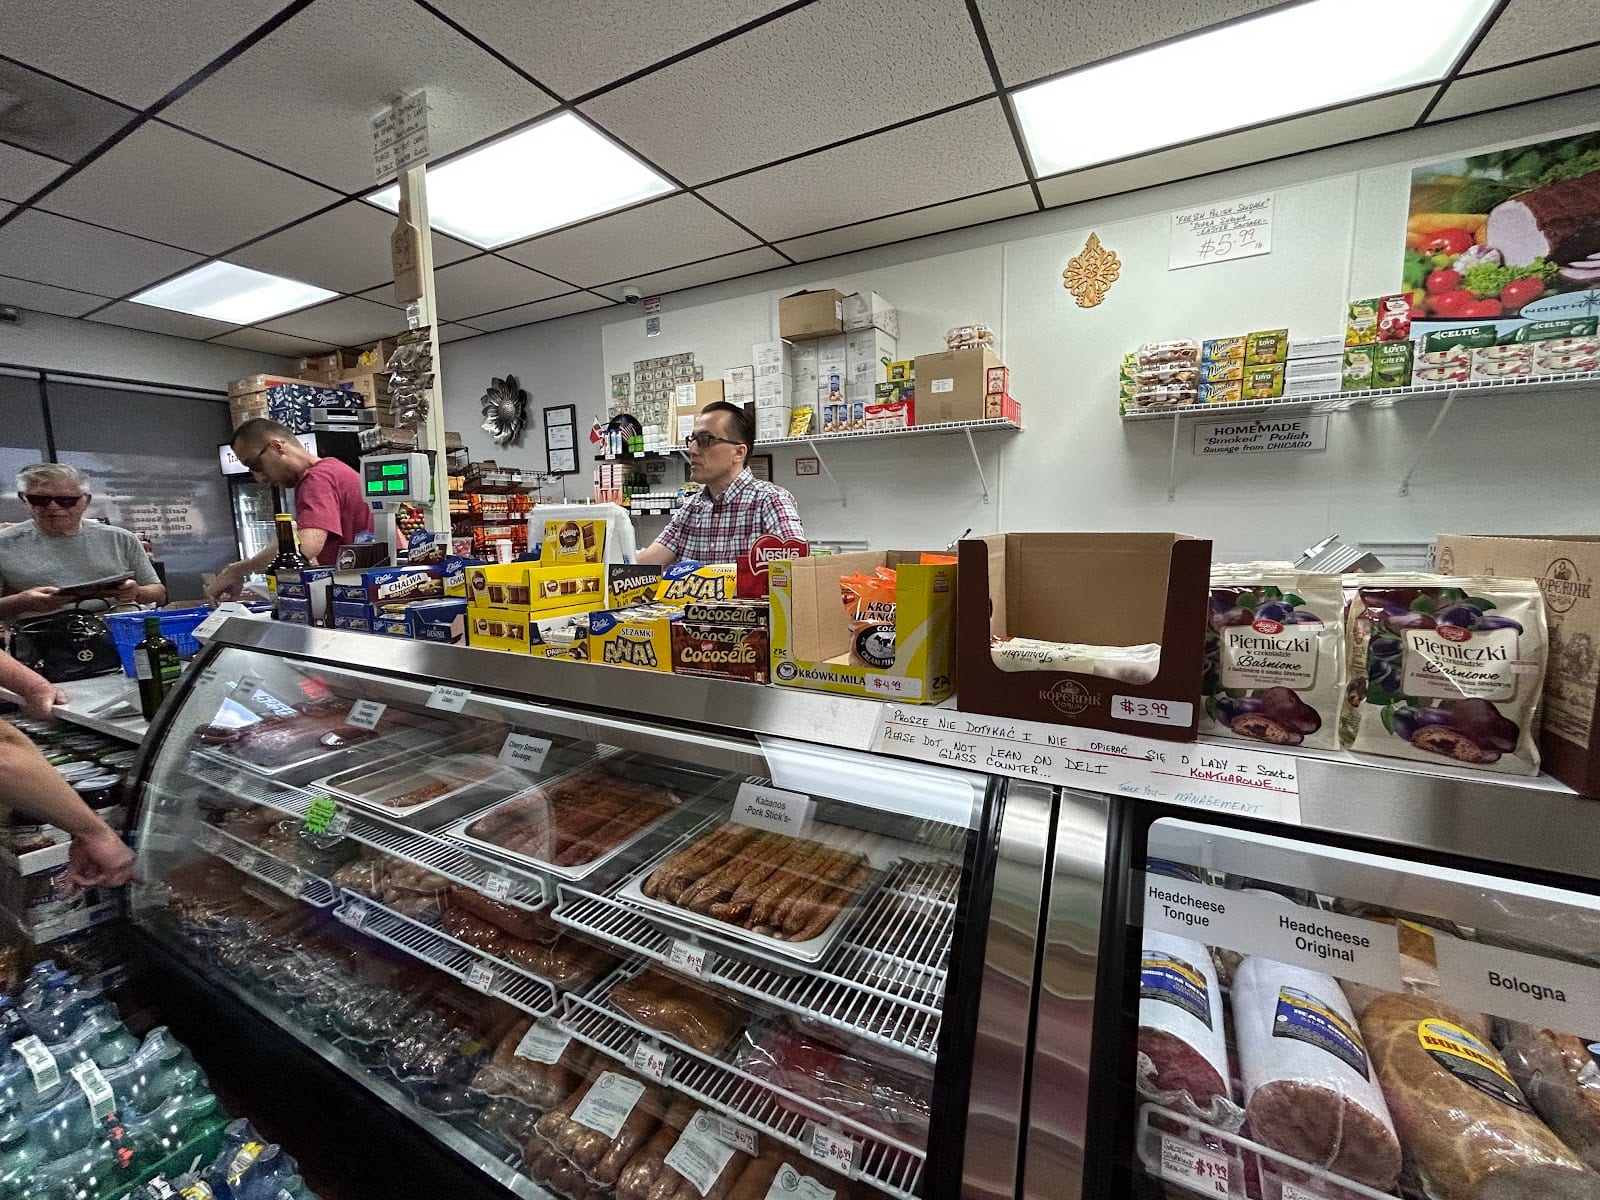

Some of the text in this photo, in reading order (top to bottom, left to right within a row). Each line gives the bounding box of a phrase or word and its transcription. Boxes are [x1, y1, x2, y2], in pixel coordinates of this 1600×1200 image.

[1539, 320, 1569, 329] CELTIC
[1440, 328, 1480, 339] CELTIC
[1381, 357, 1406, 365] GREEN
[1215, 422, 1301, 436] HOMEMADE
[1205, 431, 1309, 445] "Smoked" Polish
[1203, 441, 1312, 454] Sausage from CHICAGO
[687, 605, 757, 622] Cocosette
[621, 628, 654, 638] SEZAMKI
[604, 636, 658, 668] AHA!
[1230, 634, 1310, 653] Pierniczki
[1413, 636, 1507, 661] Pierniczki
[681, 642, 757, 664] Cocosette
[1236, 655, 1302, 671] Baśniowe
[799, 668, 838, 683] KRÓWKI
[1120, 698, 1170, 719] $3.99
[508, 740, 544, 754] Cherry Smoked
[884, 726, 916, 744] PLEASE
[954, 742, 977, 752] NOT
[990, 746, 1022, 761] LEAN
[1034, 755, 1052, 766] ON
[1065, 758, 1109, 774] DELI
[938, 718, 956, 730] NIE
[966, 721, 1015, 739] DOTYKAĆ
[1023, 732, 1032, 741] I
[1048, 735, 1067, 747] NIE
[1090, 742, 1128, 755] OPIERAĆ
[1201, 757, 1228, 771] LADY
[1237, 764, 1249, 773] I
[511, 750, 532, 762] Sausage
[938, 748, 977, 764] GLASS
[756, 795, 786, 810] Kabanos
[1175, 792, 1264, 814] MANAGEMENT
[1149, 886, 1226, 914] Headcheese
[1162, 904, 1210, 927] Tongue
[1279, 915, 1370, 948] Headcheese
[1295, 936, 1355, 963] Original
[1487, 970, 1567, 1003] Bologna
